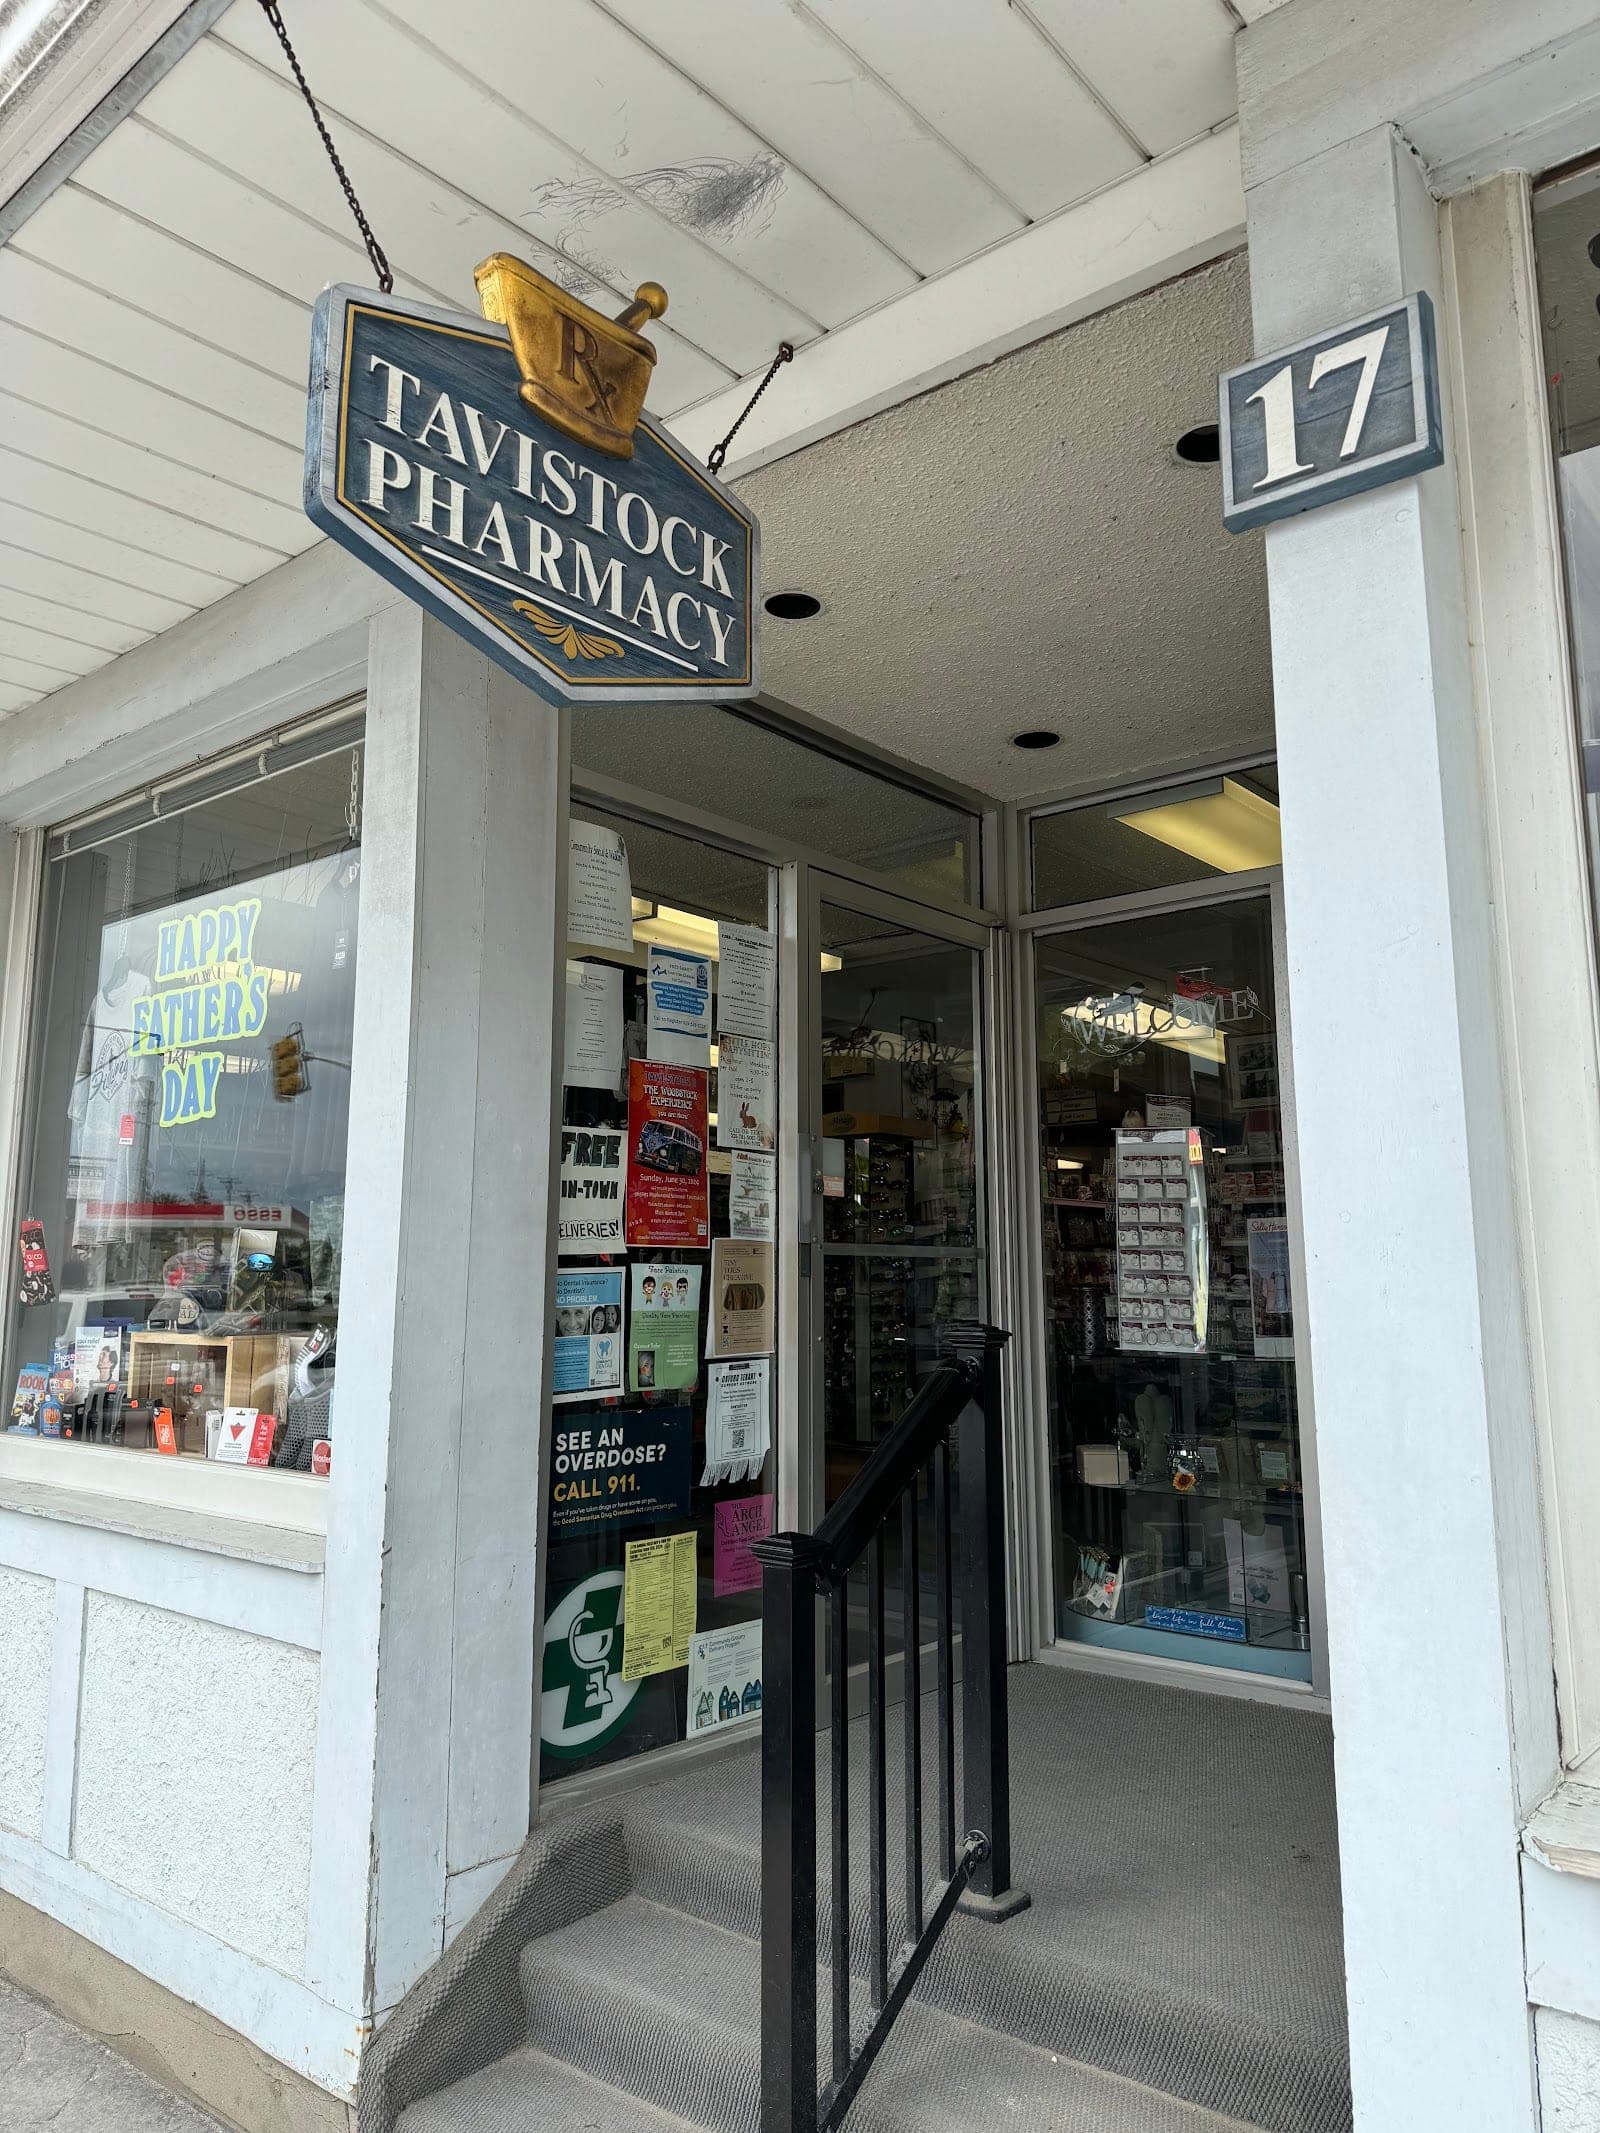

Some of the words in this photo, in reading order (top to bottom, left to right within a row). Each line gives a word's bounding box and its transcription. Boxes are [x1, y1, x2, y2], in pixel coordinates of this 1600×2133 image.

[1245, 325, 1390, 489] 17
[369, 354, 735, 600] TAVISTOCK
[360, 438, 737, 667] PHARMACY
[157, 902, 260, 980] HAPPY
[131, 966, 267, 1054] FATHER'S
[1073, 989, 1254, 1045] WELCOME
[161, 1055, 222, 1125] DAY
[643, 1084, 658, 1097] THE
[661, 1086, 698, 1100] WOODSTOCK
[650, 1096, 693, 1109] EXPERIENCE
[561, 1132, 621, 1168] FREE
[561, 1180, 618, 1199] IN-TOWN
[640, 1174, 663, 1183] Sunday,
[559, 1220, 619, 1238] ELIVERIES!
[665, 1265, 688, 1275] Painting
[19, 1374, 46, 1390] ROOK
[556, 1431, 592, 1452] SEE
[598, 1428, 624, 1448] AN
[555, 1444, 666, 1474] OVERDOSE?
[554, 1478, 602, 1502] CALL
[608, 1473, 640, 1494] 911.
[562, 1516, 575, 1525] Good
[733, 1505, 762, 1522] ARCH
[732, 1519, 769, 1536] ANGEL
